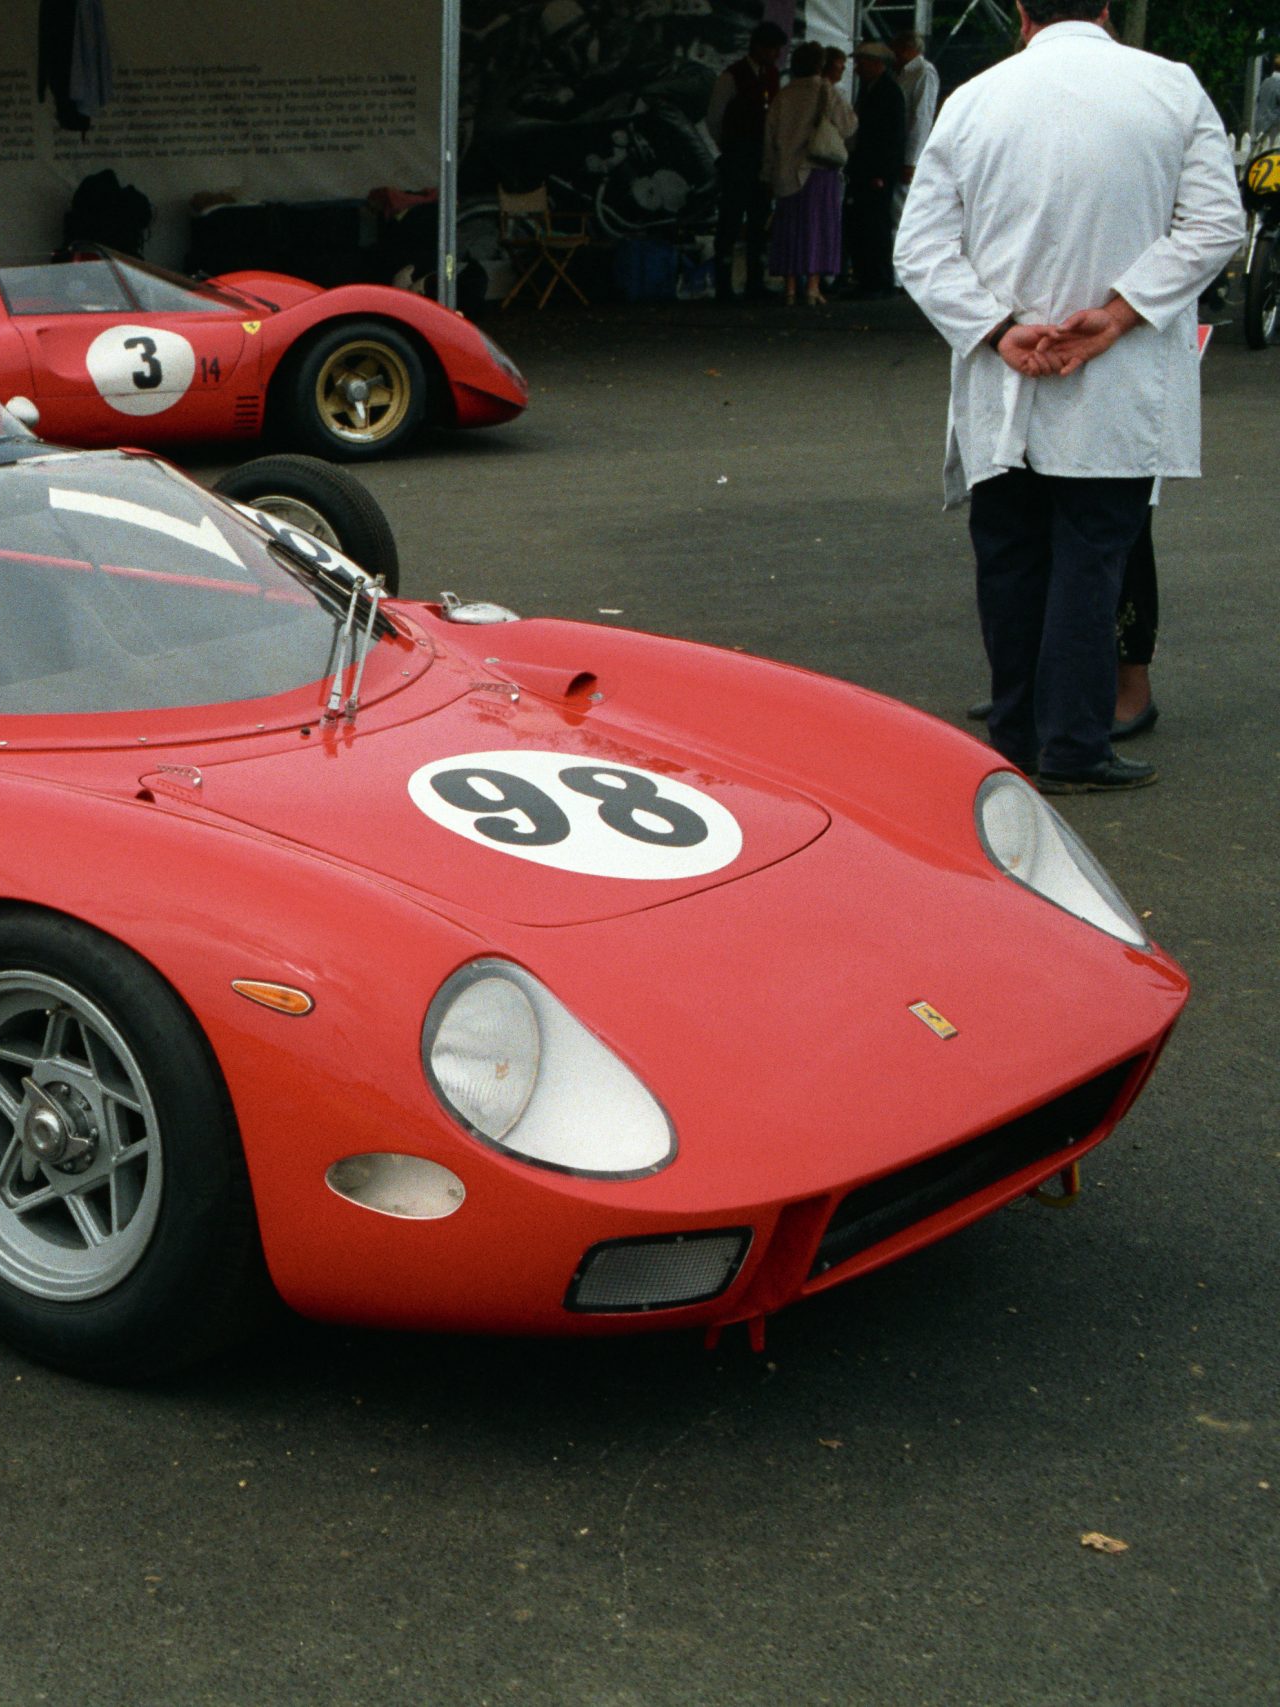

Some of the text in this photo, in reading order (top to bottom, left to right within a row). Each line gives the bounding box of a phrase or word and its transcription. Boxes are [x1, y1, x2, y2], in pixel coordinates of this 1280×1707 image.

[123, 336, 163, 389] 3
[200, 357, 221, 383] 14
[430, 766, 709, 848] 98
